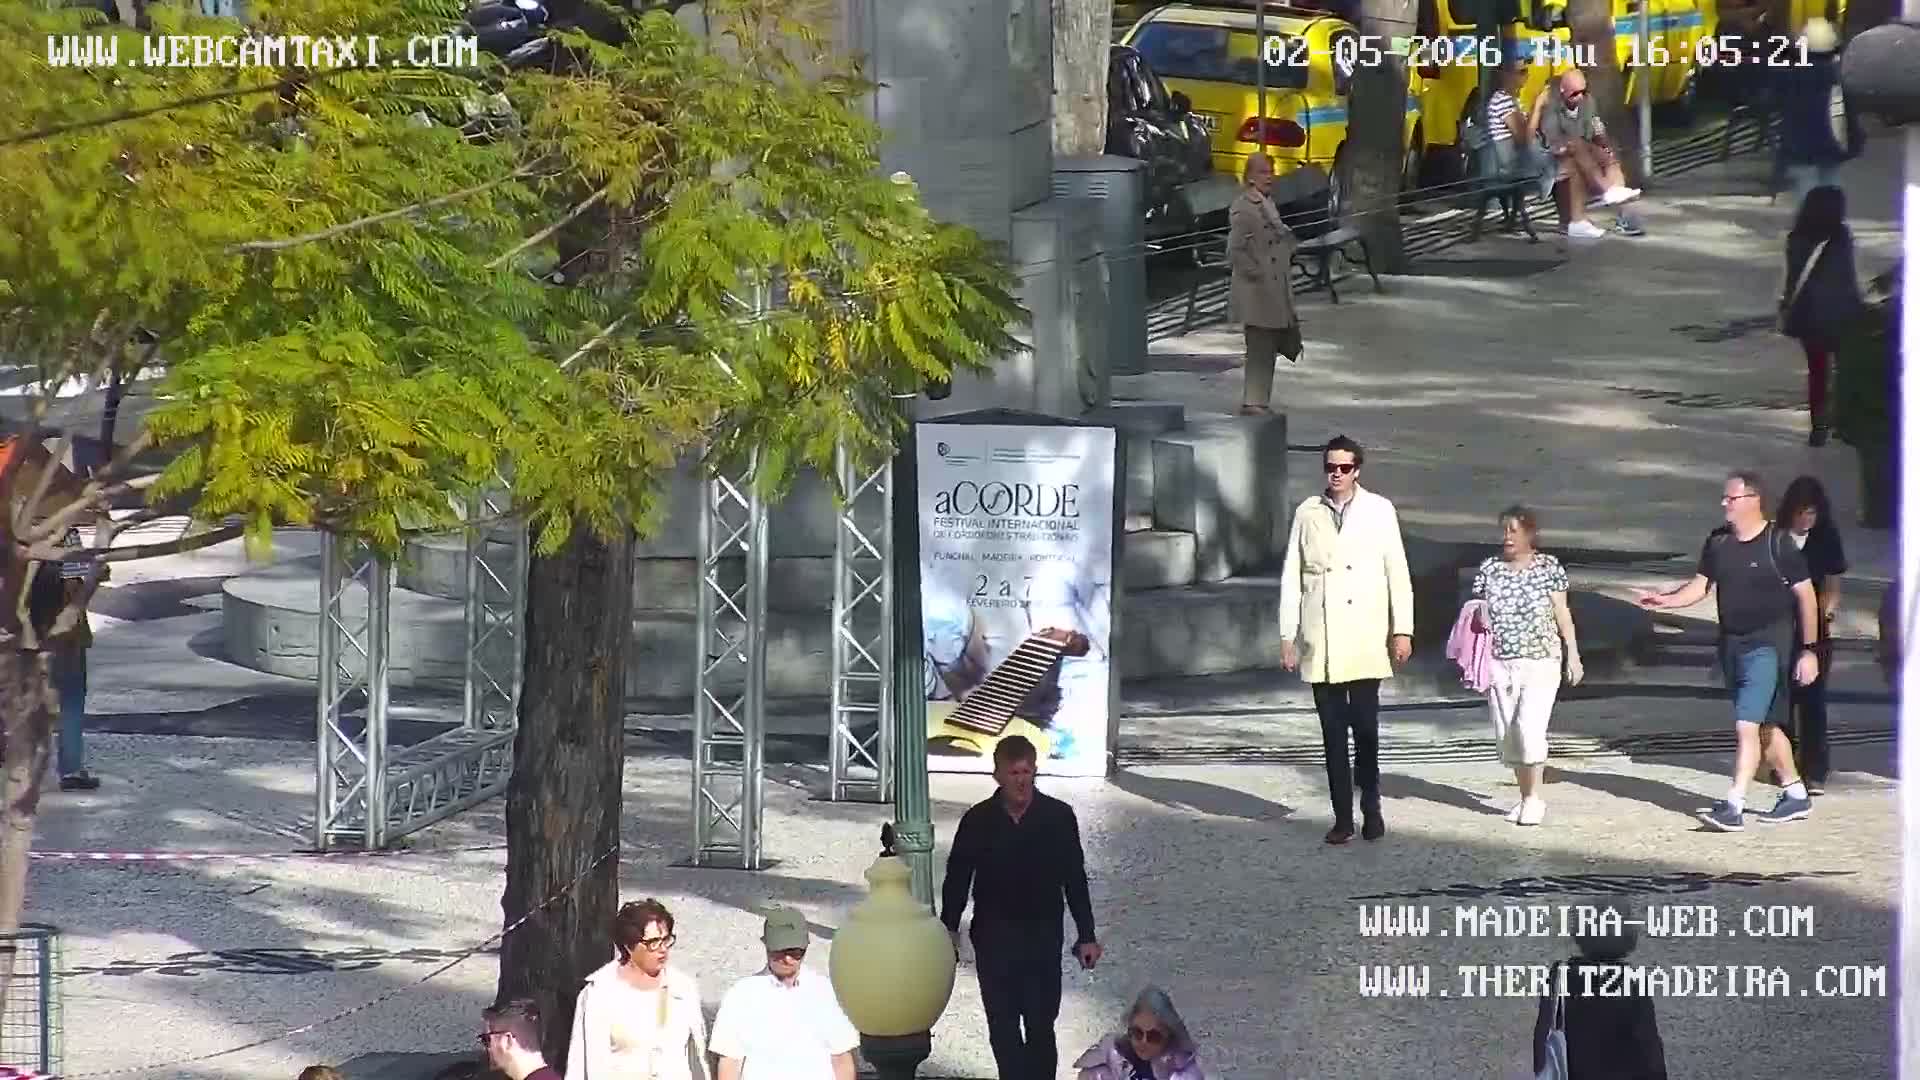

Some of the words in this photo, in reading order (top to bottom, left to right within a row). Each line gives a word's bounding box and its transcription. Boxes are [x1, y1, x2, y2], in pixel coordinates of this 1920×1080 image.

[934, 517, 984, 529] FESTIVAL
[987, 519, 1080, 531] INTERNACIONAL
[934, 552, 974, 561] FUNCHAL
[982, 552, 1022, 561] MADEIRA
[975, 574, 988, 597] 2
[999, 579, 1011, 597] a
